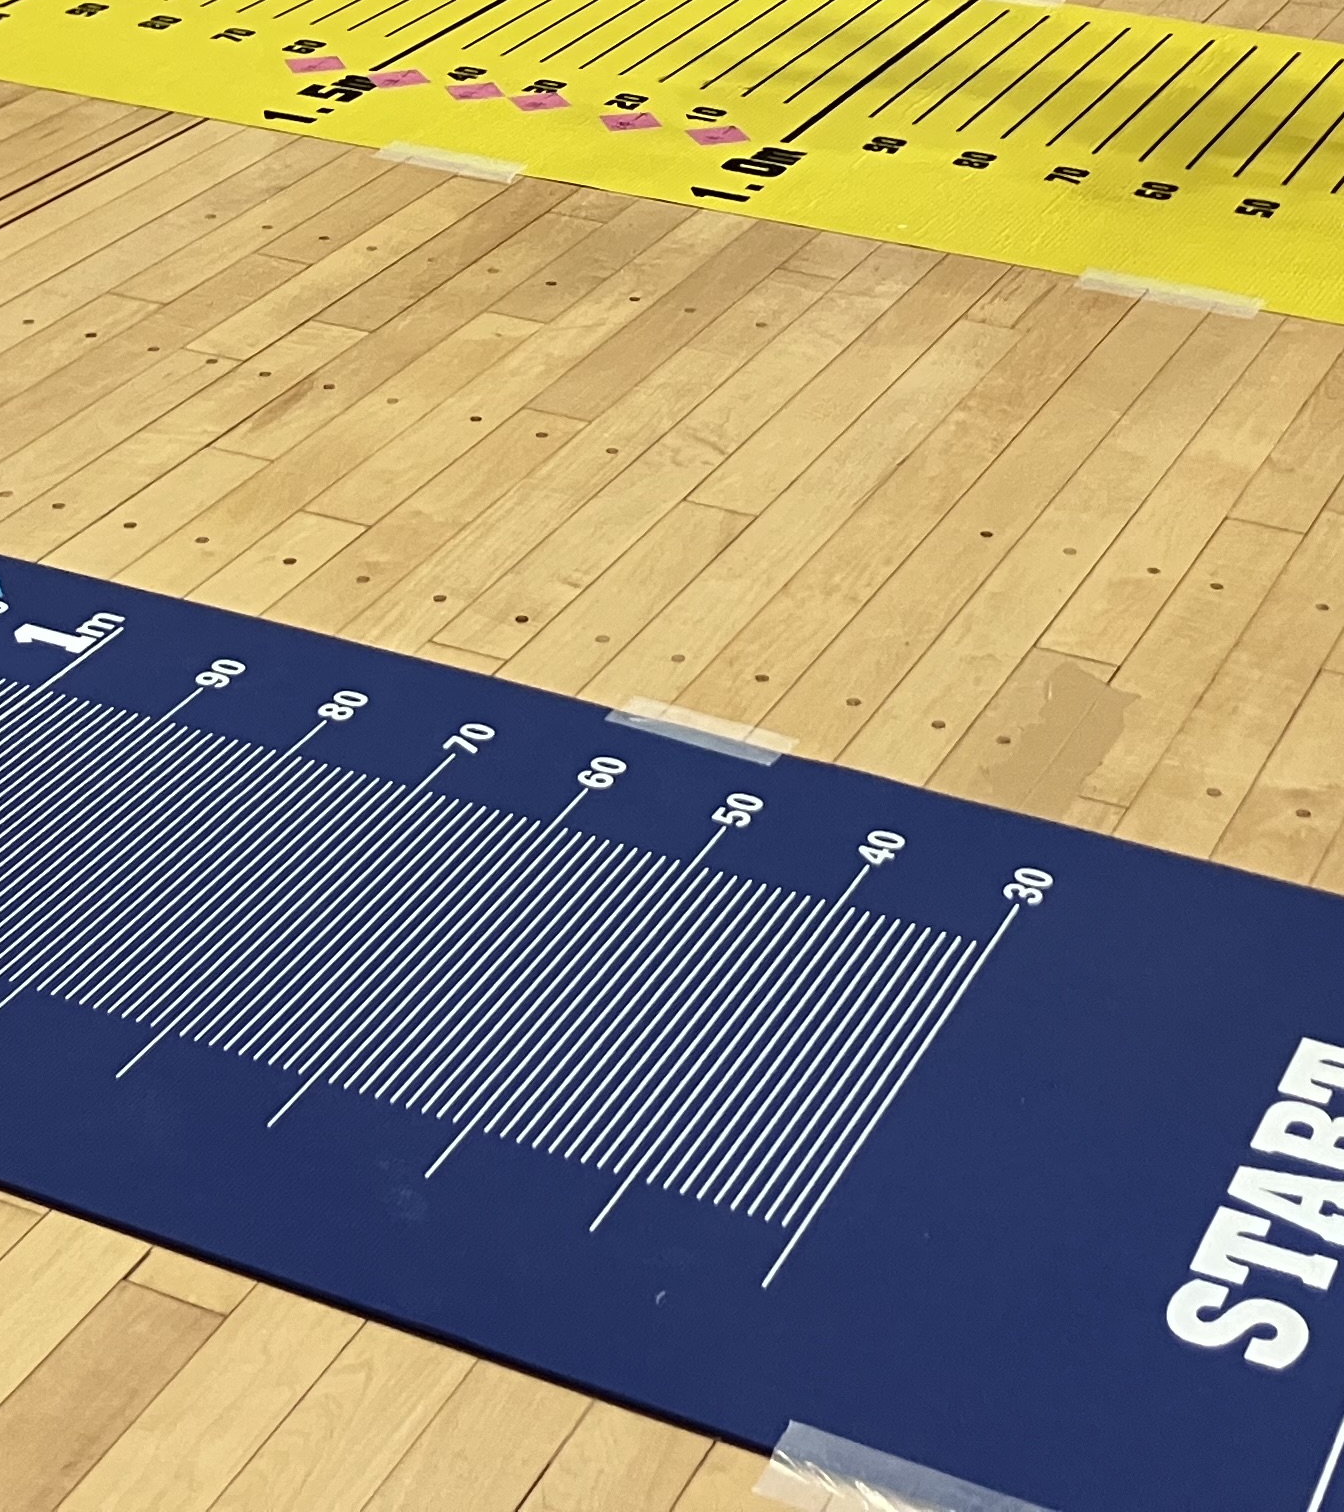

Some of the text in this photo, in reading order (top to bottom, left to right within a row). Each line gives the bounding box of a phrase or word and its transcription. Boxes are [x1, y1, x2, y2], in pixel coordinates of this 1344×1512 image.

[65, 2, 110, 18] 90
[137, 15, 182, 30] 80
[211, 27, 256, 42] 70
[281, 39, 327, 55] 60
[447, 66, 488, 82] 40
[521, 79, 568, 94] 30
[263, 74, 378, 124] 1.5m
[604, 93, 649, 111] 20
[685, 106, 728, 123] 10
[862, 136, 908, 155] 90
[952, 151, 998, 170] 80
[690, 147, 808, 203] 1.0m
[1043, 166, 1090, 185] 70
[1133, 181, 1179, 201] 60
[1234, 198, 1281, 219] 50
[14, 612, 125, 654] 1m
[195, 659, 246, 688] 90
[317, 690, 368, 721] 80
[442, 723, 495, 754] 70
[577, 756, 627, 788] 60
[711, 793, 764, 828] 50
[858, 830, 906, 865] 40
[1003, 868, 1053, 904] 30
